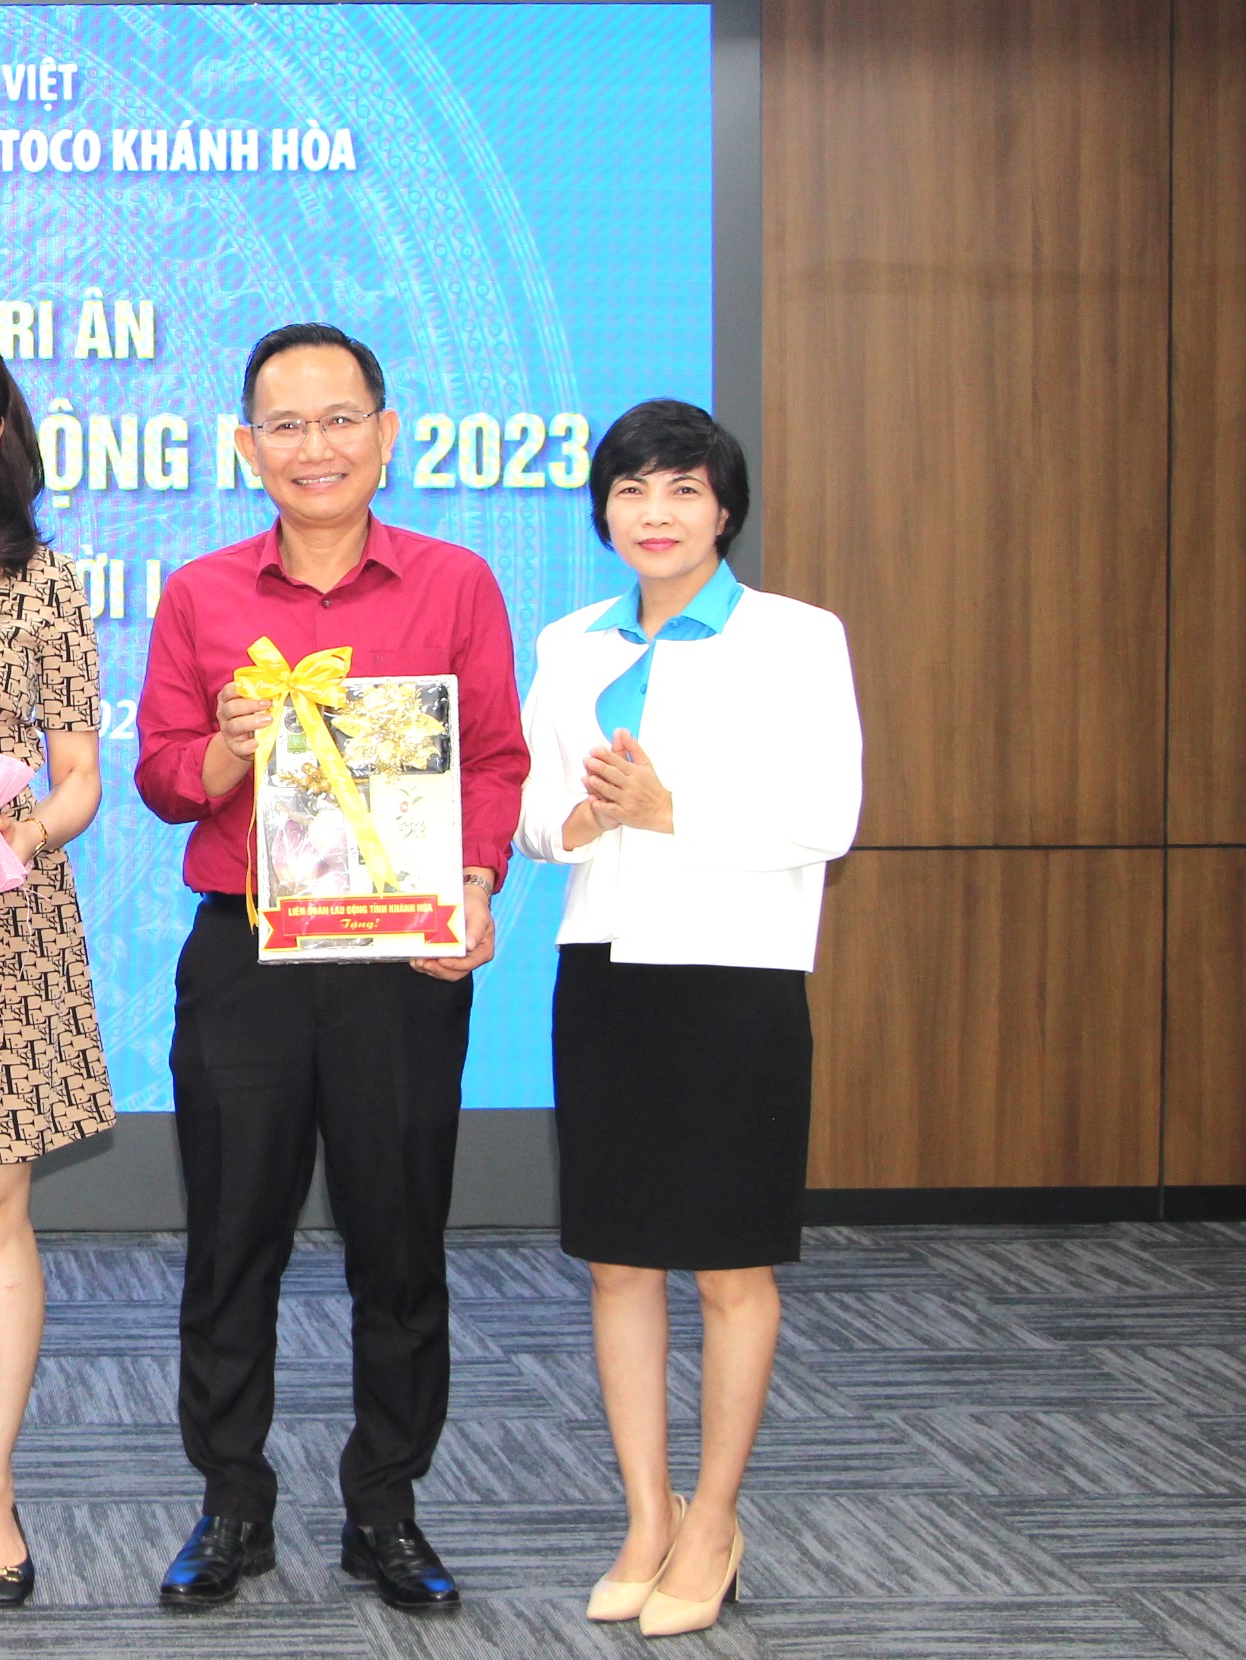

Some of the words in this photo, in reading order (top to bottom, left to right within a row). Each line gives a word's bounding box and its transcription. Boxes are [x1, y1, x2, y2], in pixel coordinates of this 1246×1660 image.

[2, 56, 77, 112] VIỆT
[111, 120, 258, 172] KHÁNH
[270, 118, 357, 170] HÒA
[75, 286, 155, 360] ÂN
[40, 398, 189, 508] ỘNG
[414, 411, 592, 491] 2023
[288, 905, 305, 917] LIÊN
[330, 906, 345, 915] LAO
[340, 918, 380, 931] Tặng!
